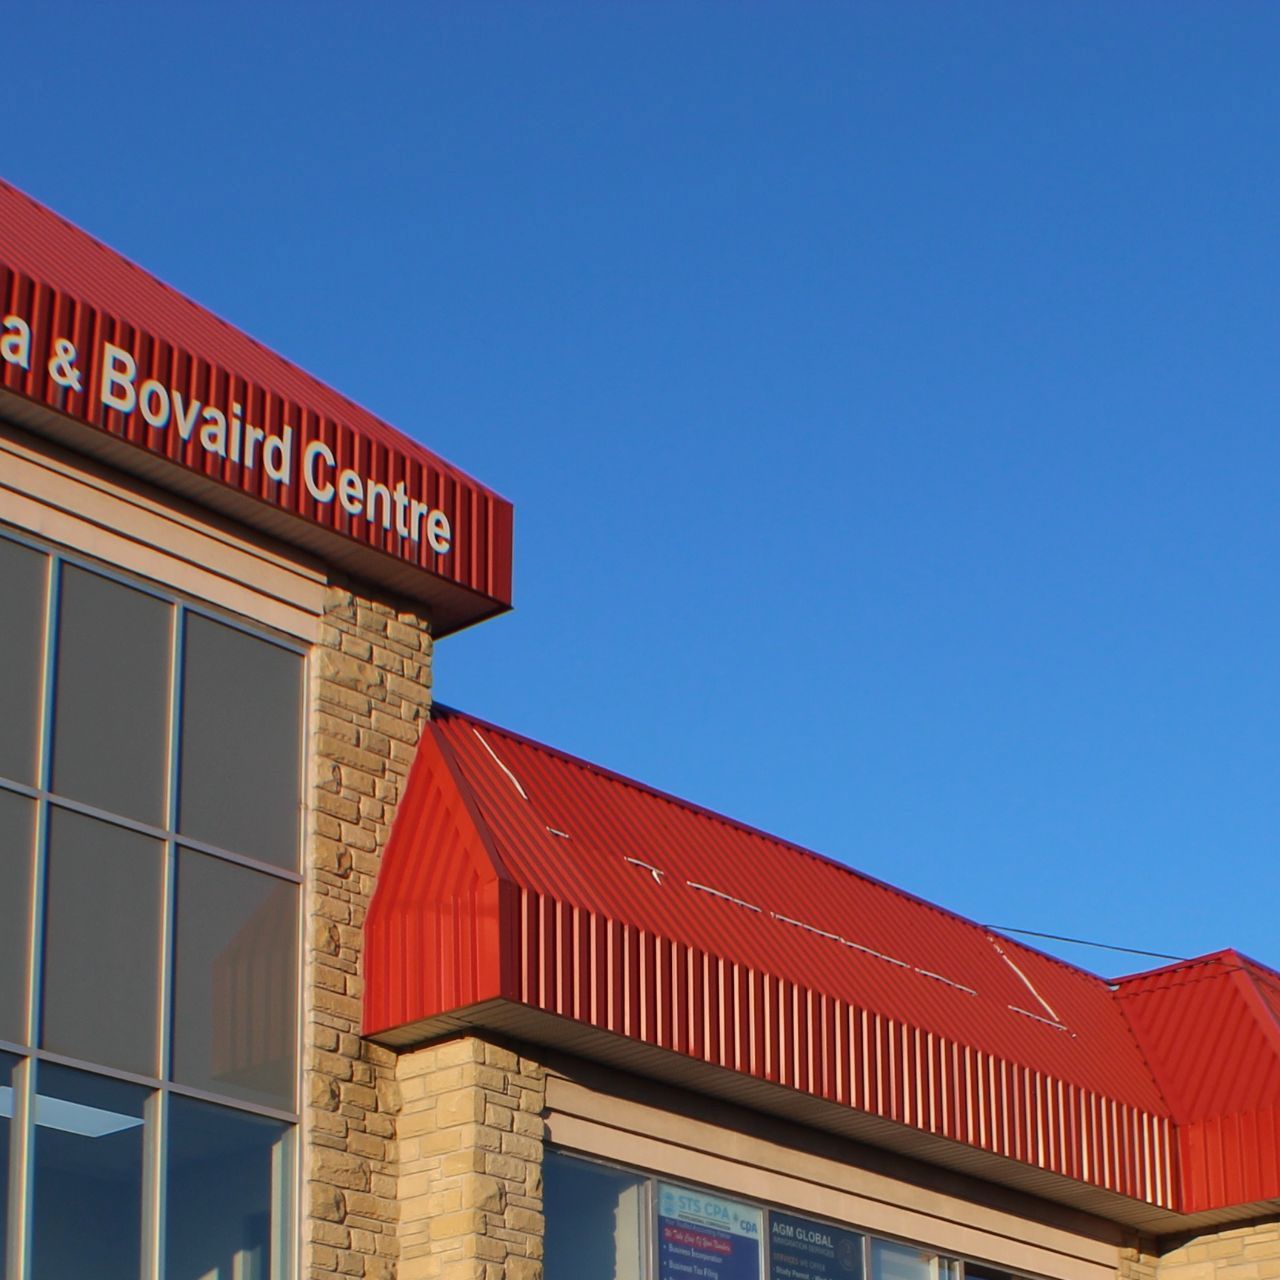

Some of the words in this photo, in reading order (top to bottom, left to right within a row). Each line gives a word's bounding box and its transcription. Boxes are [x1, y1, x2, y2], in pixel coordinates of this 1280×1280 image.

[48, 339, 83, 392] &
[100, 341, 293, 485] Bovaird
[302, 442, 452, 556] Centre
[677, 1196, 701, 1214] STS
[703, 1201, 731, 1221] CPA
[772, 1222, 794, 1237] AGM
[795, 1228, 834, 1249] GLOBAL
